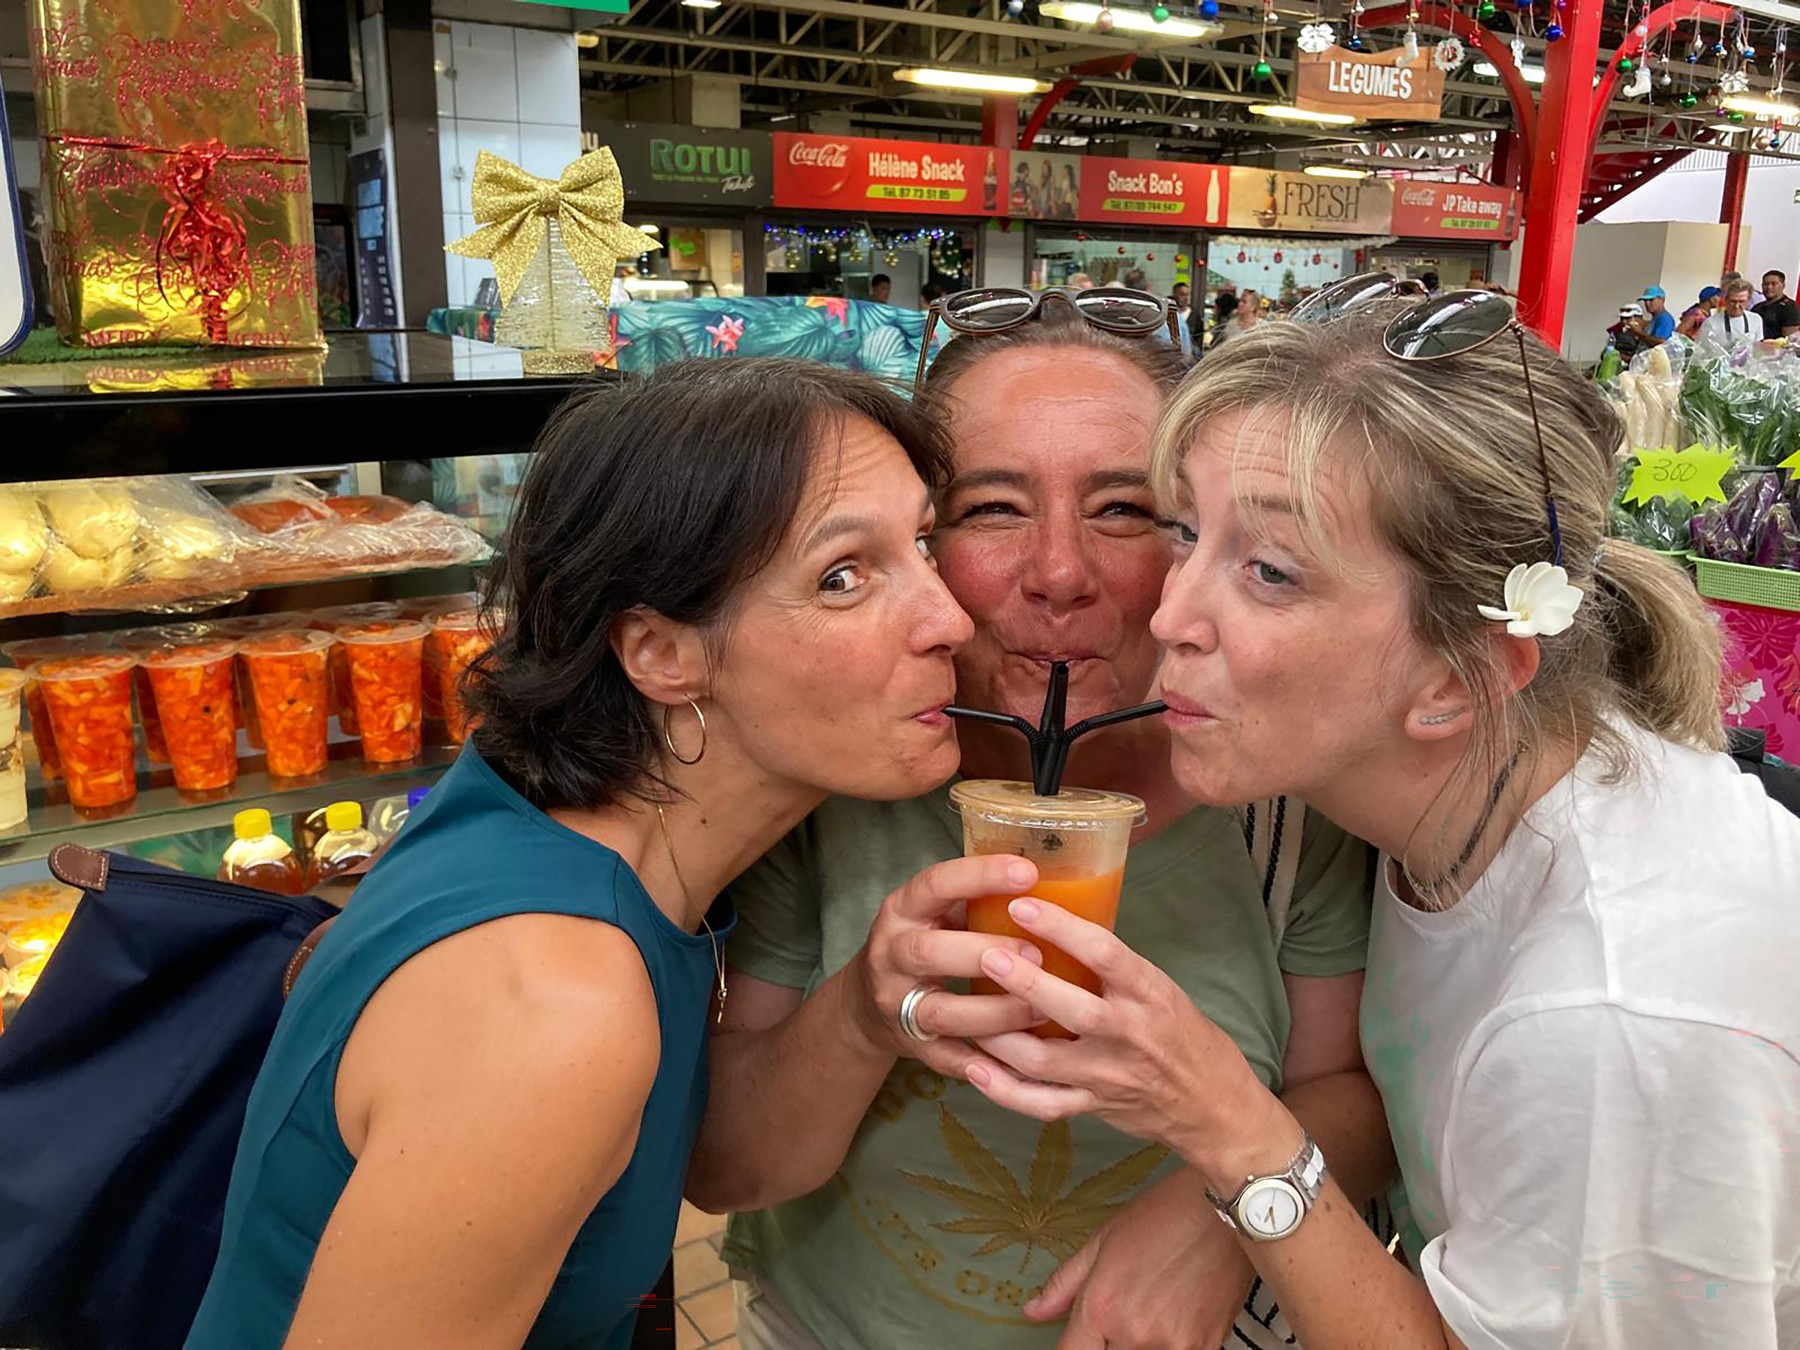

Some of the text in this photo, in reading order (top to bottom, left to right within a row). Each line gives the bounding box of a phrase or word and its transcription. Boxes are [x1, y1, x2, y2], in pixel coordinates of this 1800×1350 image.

[1328, 60, 1413, 100] LEGUMES
[868, 152, 966, 182] Hélène Snack
[1107, 169, 1183, 196] Snack Bon's
[1282, 181, 1360, 219] FRESH
[1442, 194, 1502, 219] JP Take away
[1652, 459, 1698, 482] 300
